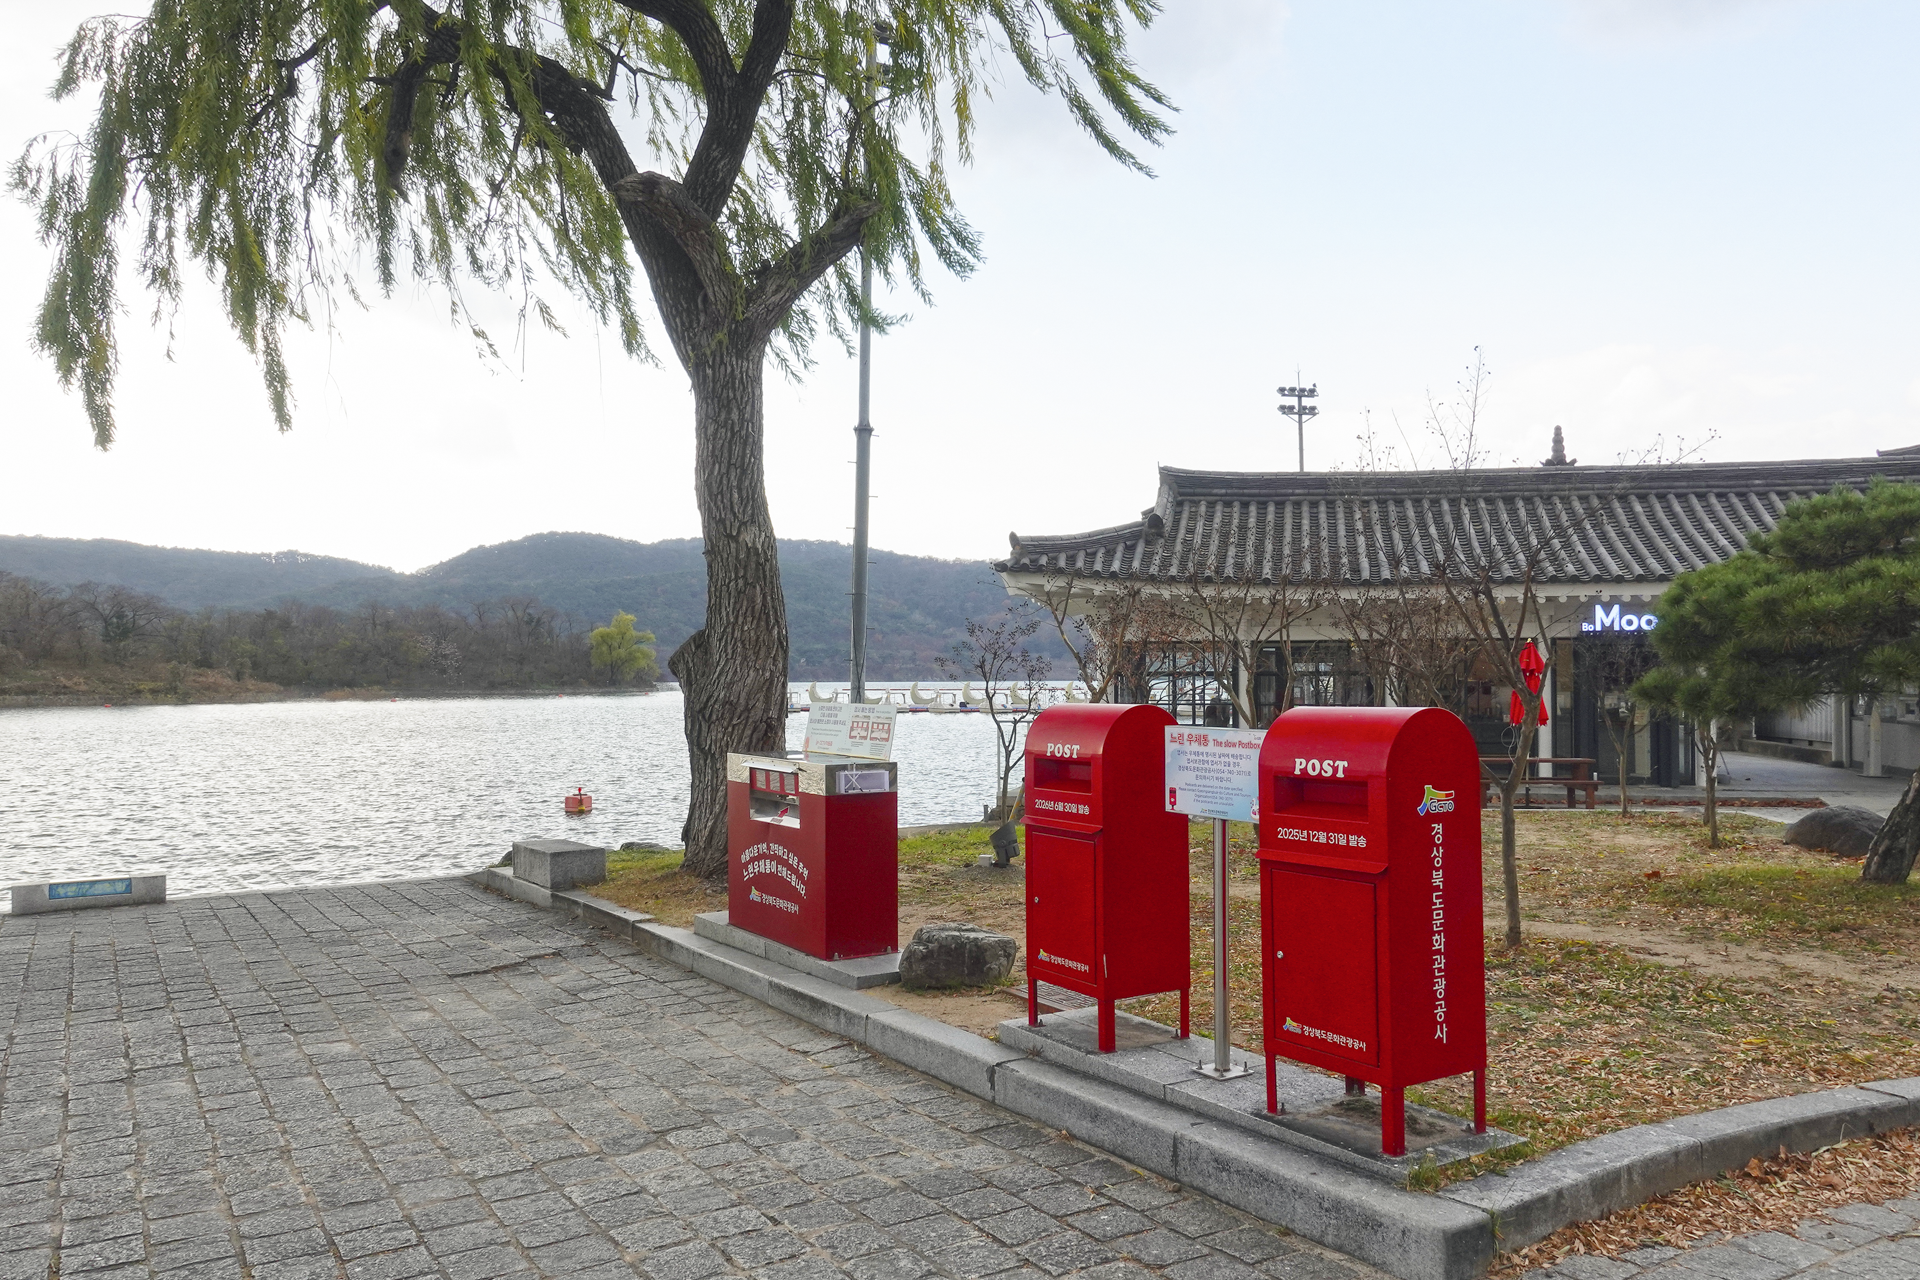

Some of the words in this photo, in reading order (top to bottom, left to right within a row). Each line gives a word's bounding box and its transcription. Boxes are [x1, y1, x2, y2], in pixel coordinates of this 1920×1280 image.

[1046, 743, 1080, 758] POST
[1170, 733, 1184, 745] 느린
[1186, 733, 1210, 747] 우체통
[1213, 738, 1223, 748] The
[1224, 739, 1236, 748] slow
[1238, 740, 1261, 750] Postbox
[1294, 758, 1348, 778] POST
[1034, 799, 1054, 810] 2026년
[1054, 801, 1064, 811] 6월
[1064, 802, 1077, 813] 30일
[1078, 804, 1090, 815] 발송
[1277, 827, 1308, 842] 2025년
[1308, 829, 1327, 844] 12월
[1328, 832, 1347, 846] 31일
[1348, 832, 1367, 848] 발송
[770, 843, 788, 860] 간직하고
[788, 852, 798, 868] 싶은
[798, 862, 809, 880] 추억
[777, 864, 807, 899] 전해드립니다.
[762, 893, 799, 915] 경상북도문화관광공사
[1430, 822, 1448, 1045] 경상북도문화관광공사
[1050, 955, 1089, 973] 경상북도문화관광공사
[1302, 1025, 1366, 1052] 경상북도문화관광공사
